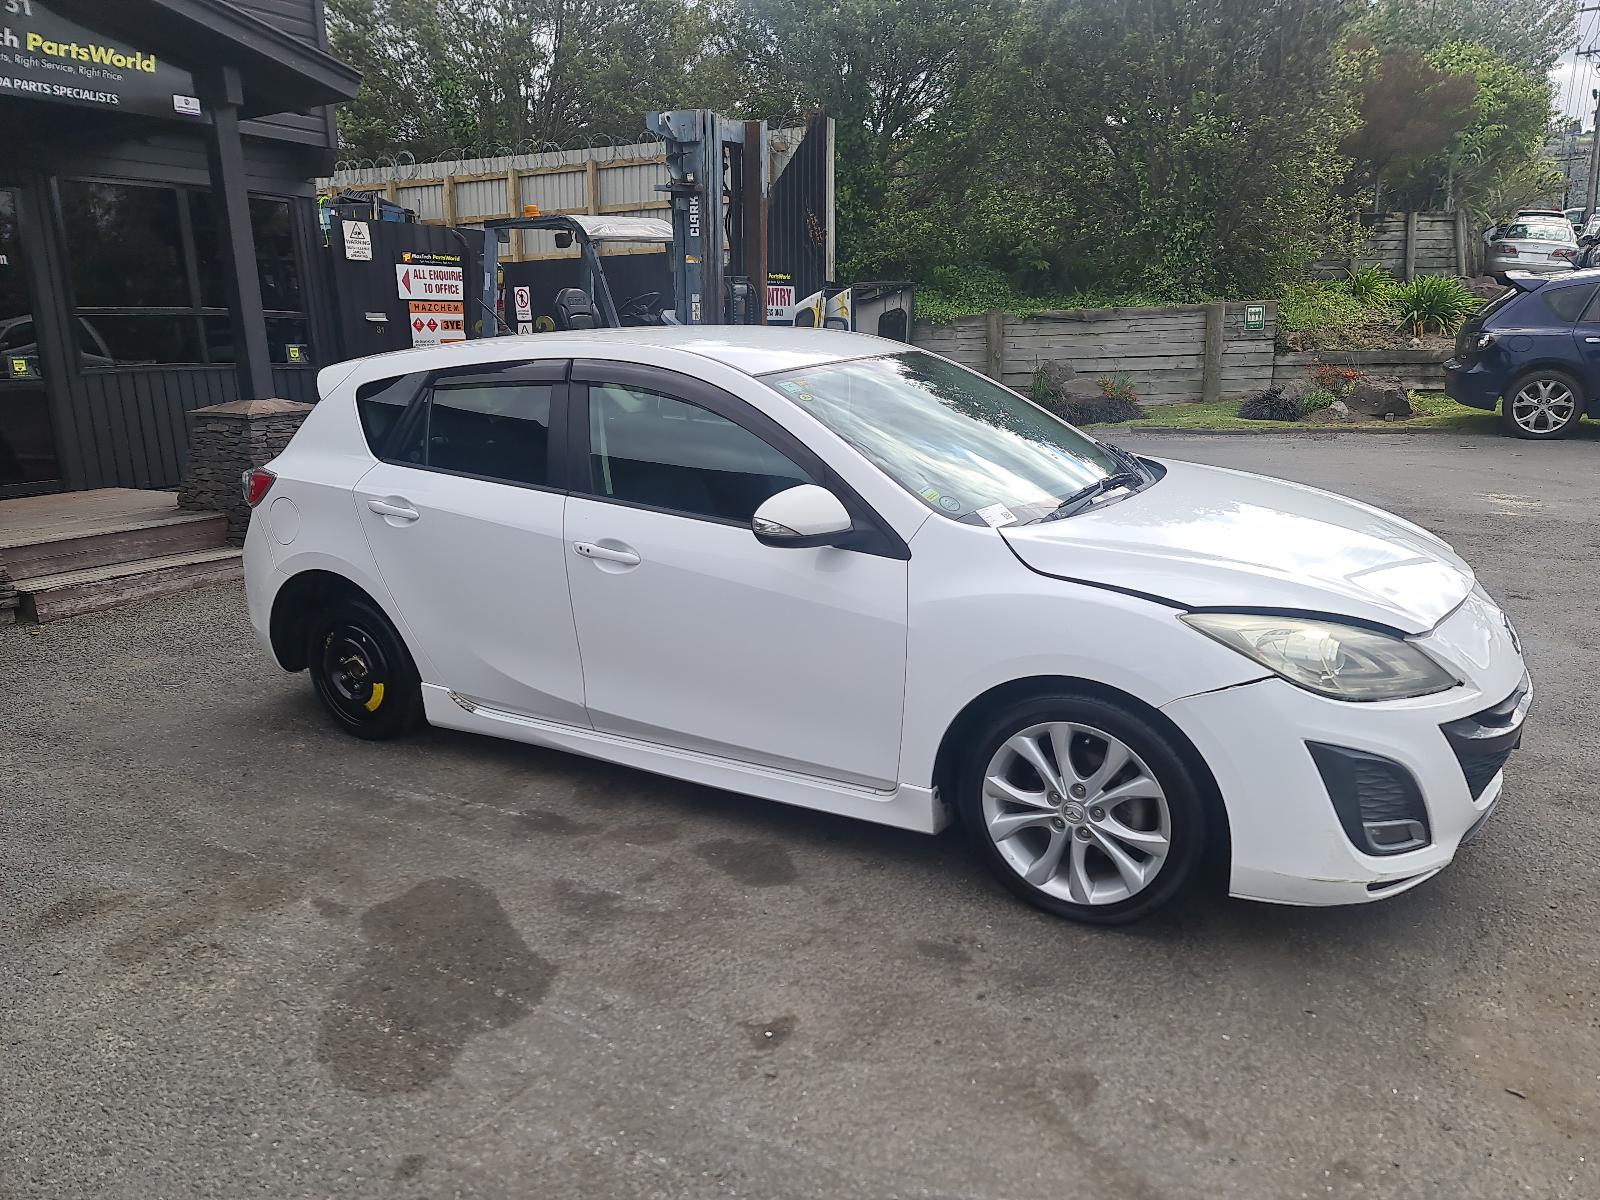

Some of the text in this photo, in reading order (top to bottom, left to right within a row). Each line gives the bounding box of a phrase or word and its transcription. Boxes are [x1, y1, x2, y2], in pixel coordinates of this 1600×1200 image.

[26, 31, 156, 73] PartsWorld
[14, 54, 39, 68] Right
[41, 59, 76, 74] Service,
[79, 66, 100, 78] Right
[102, 70, 123, 81] Price
[13, 79, 52, 94] PARTS
[53, 85, 119, 104] SPECIALISTS
[689, 195, 700, 237] CLARK
[432, 254, 461, 262] PartsWorld
[413, 268, 427, 280] ALL
[424, 283, 460, 295] TO OFFICE
[414, 303, 460, 312] HAZCHEM
[376, 325, 385, 335] 31
[443, 320, 462, 330] 3YE
